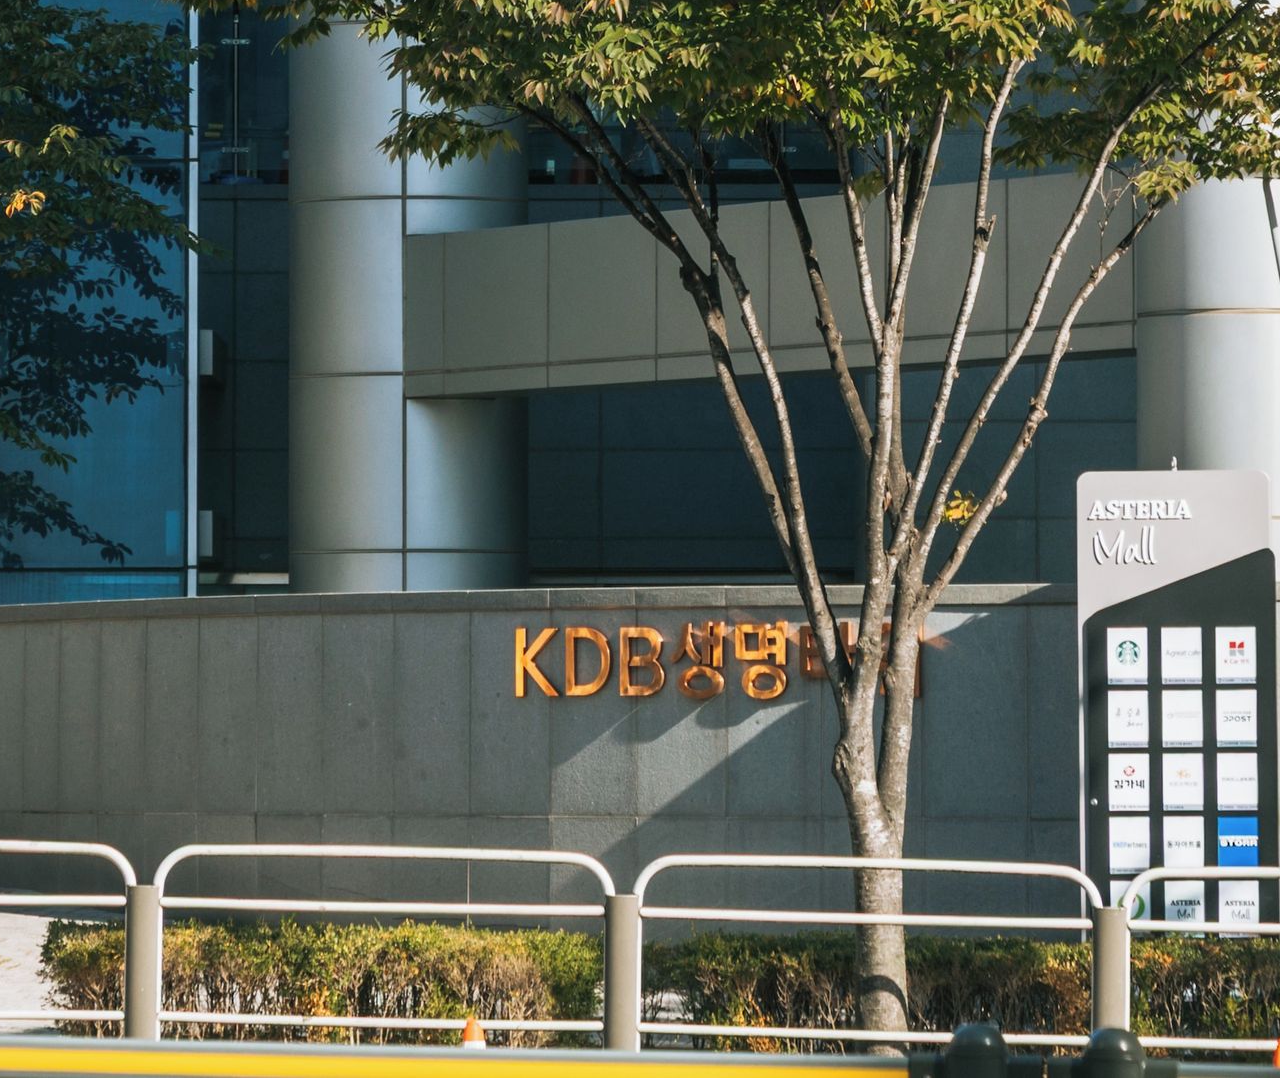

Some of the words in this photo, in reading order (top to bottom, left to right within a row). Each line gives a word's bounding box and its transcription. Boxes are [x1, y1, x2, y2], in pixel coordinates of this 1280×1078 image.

[1087, 499, 1193, 521] ASTERIA
[1093, 524, 1158, 566] Mall
[1114, 779, 1145, 789] 김가네
